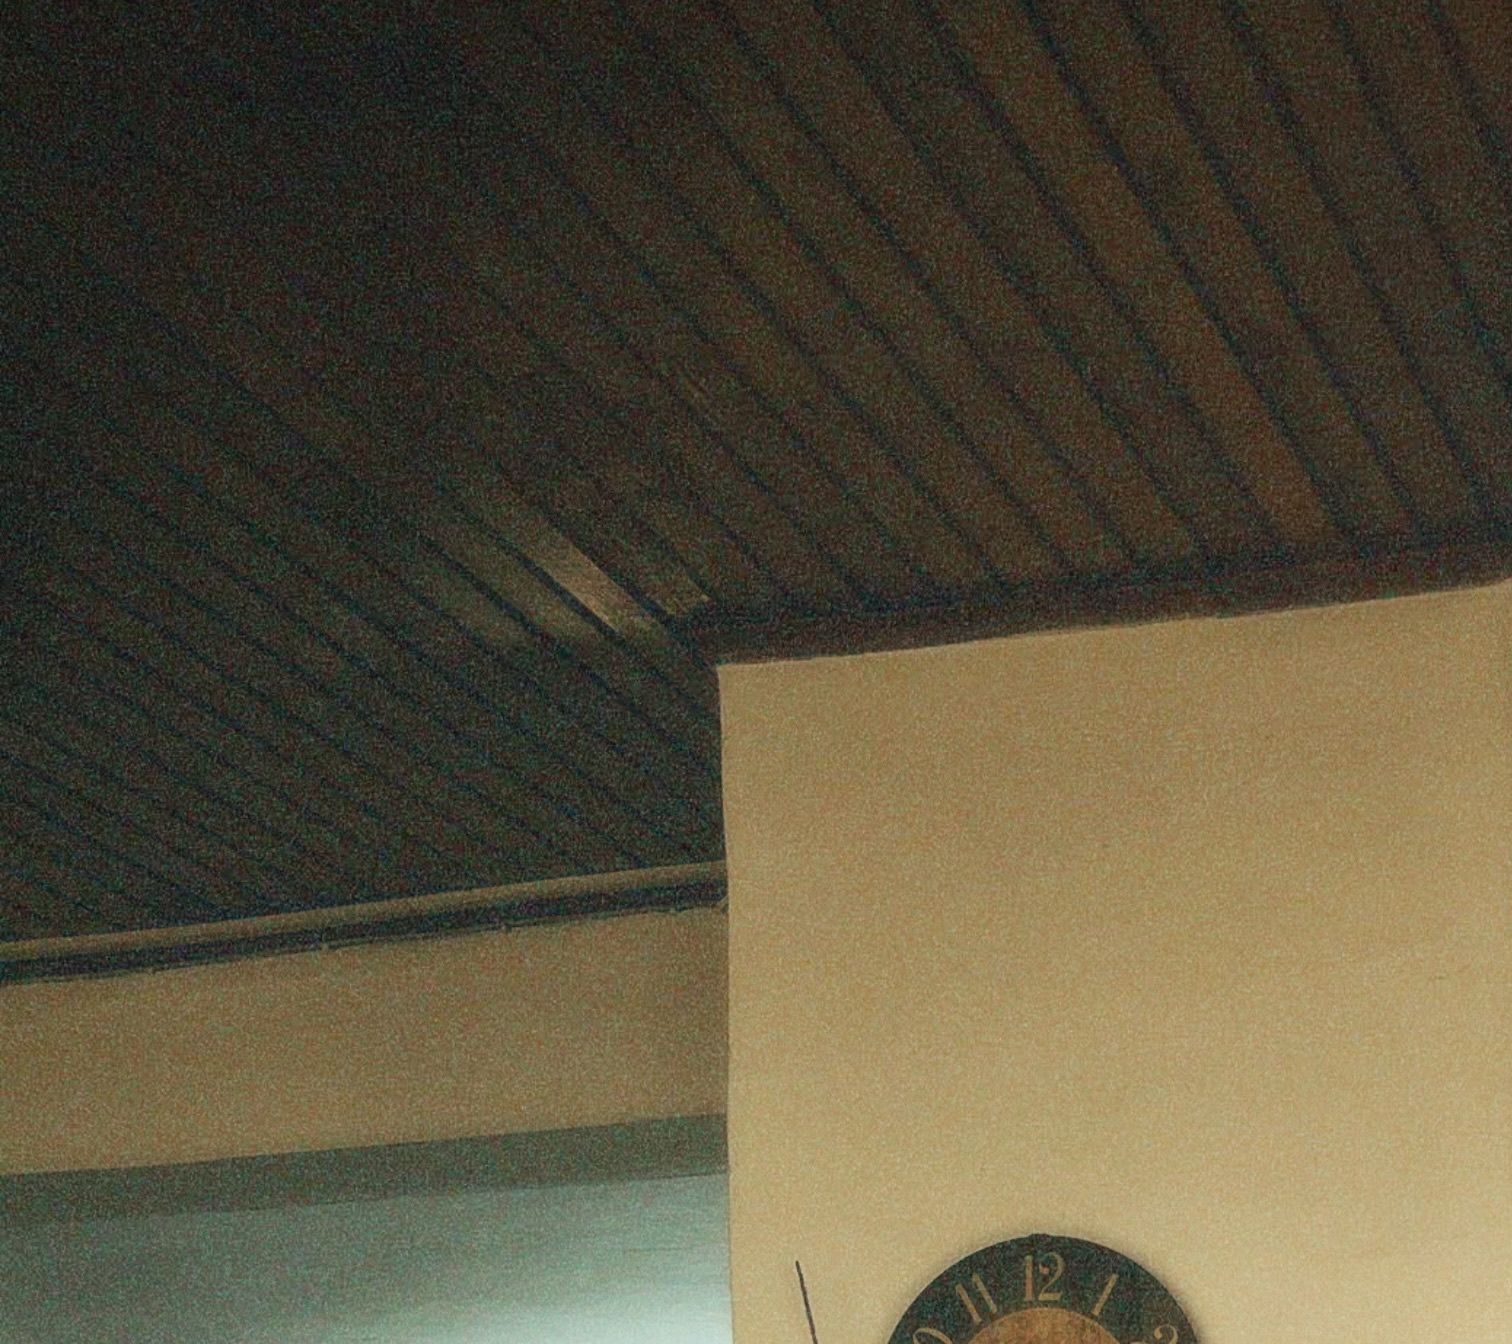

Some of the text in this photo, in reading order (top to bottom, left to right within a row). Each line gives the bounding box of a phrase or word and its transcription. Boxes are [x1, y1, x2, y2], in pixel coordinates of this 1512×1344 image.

[955, 1272, 998, 1323] 11
[1023, 1251, 1066, 1301] 12
[1092, 1272, 1119, 1316] 1
